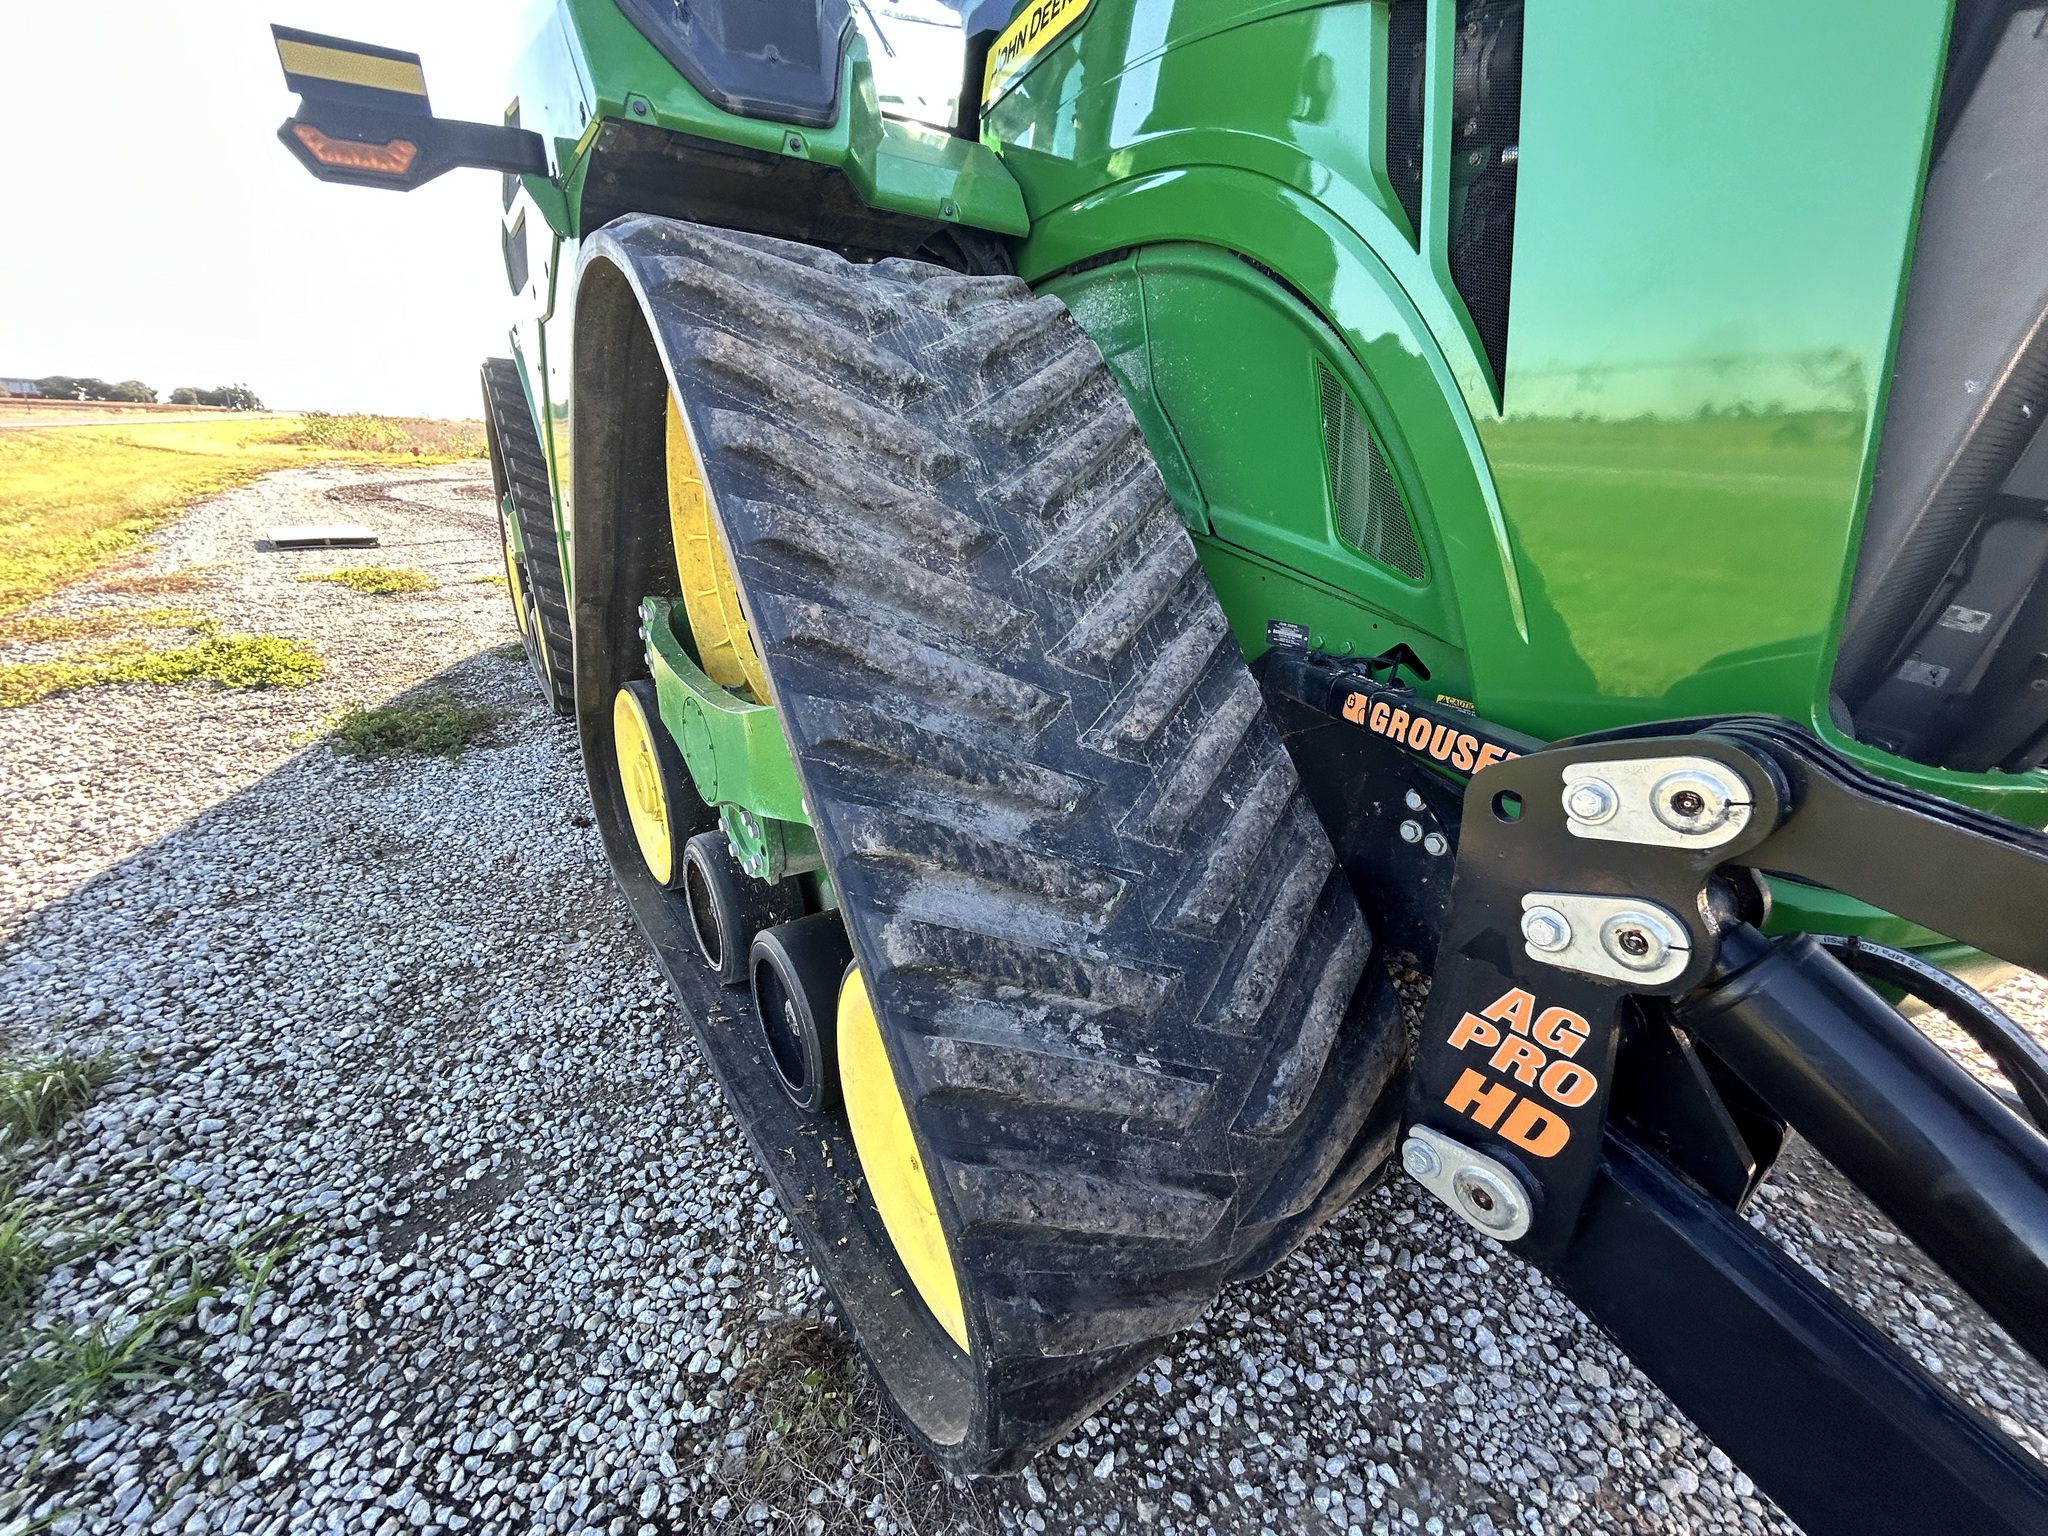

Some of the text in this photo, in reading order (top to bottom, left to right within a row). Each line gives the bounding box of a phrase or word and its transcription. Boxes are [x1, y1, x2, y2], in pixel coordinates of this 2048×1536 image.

[991, 24, 1028, 81] JOHN
[1369, 702, 1521, 775] GROUSE
[1479, 987, 1591, 1058] AG
[1446, 1012, 1598, 1108] PRO
[1444, 1067, 1571, 1158] HD
